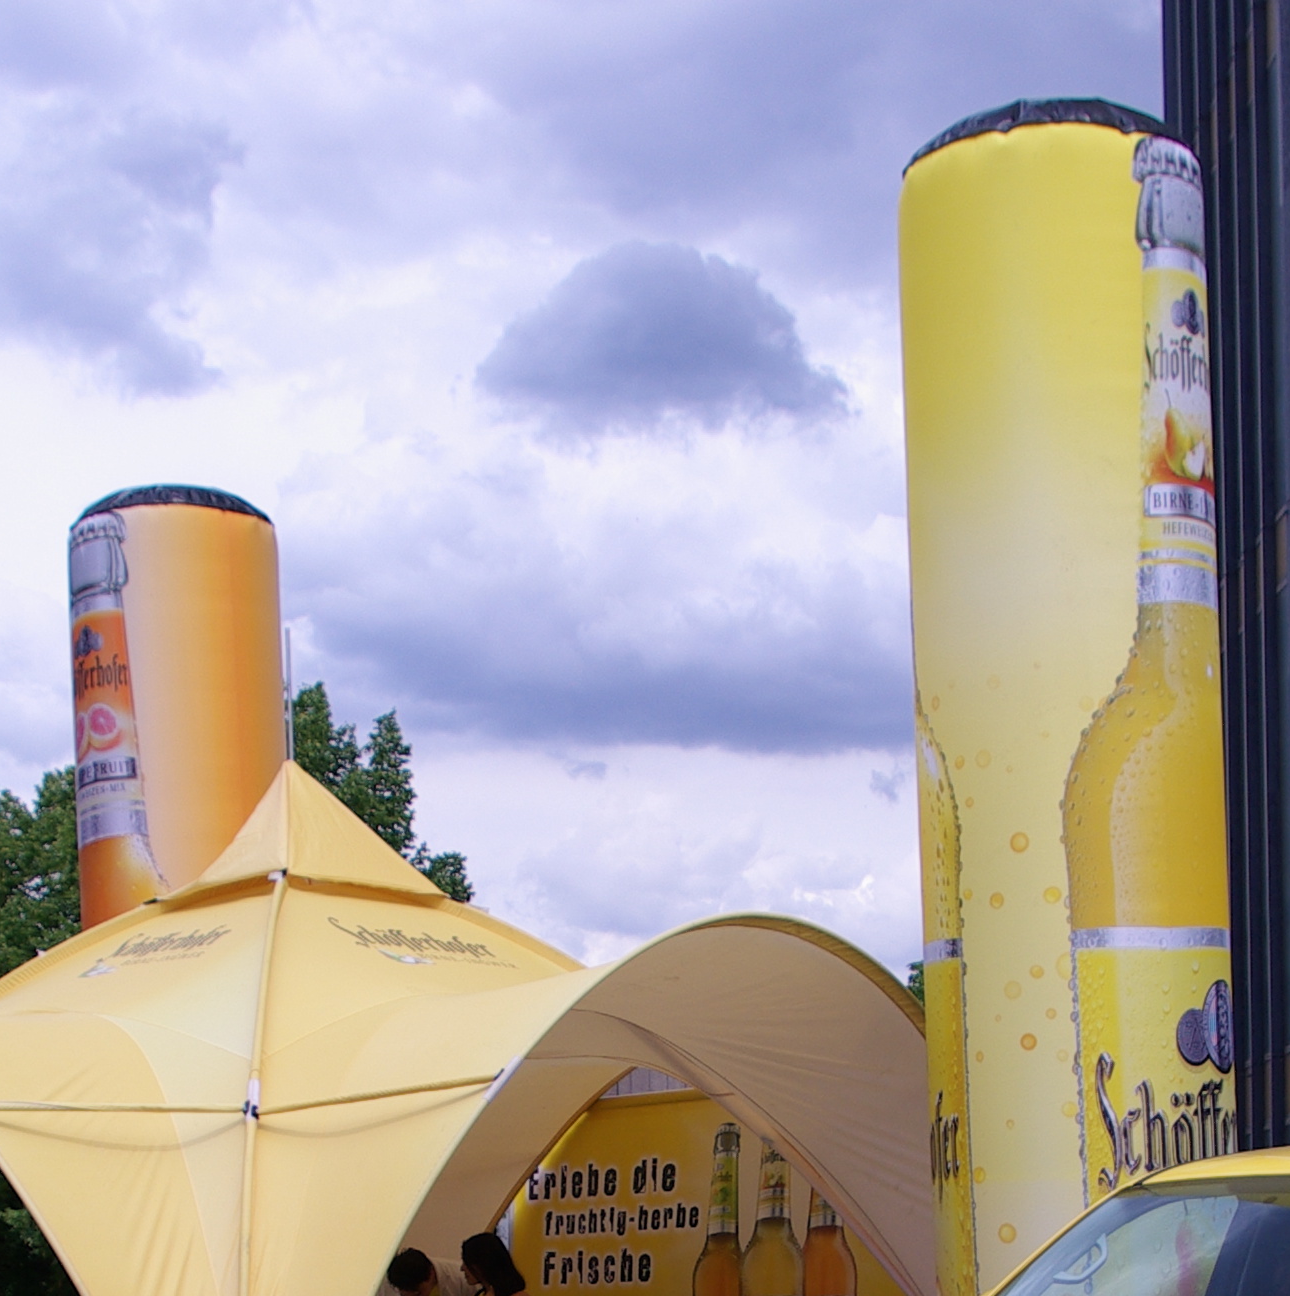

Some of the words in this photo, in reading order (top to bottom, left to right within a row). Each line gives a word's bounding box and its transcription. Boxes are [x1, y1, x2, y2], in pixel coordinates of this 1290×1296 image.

[326, 916, 496, 958] Schöfferhofer
[528, 1164, 618, 1200] Erlebe
[632, 1157, 677, 1194] die
[544, 1202, 700, 1236] fruchtig-herbe
[543, 1249, 651, 1285] Frische
